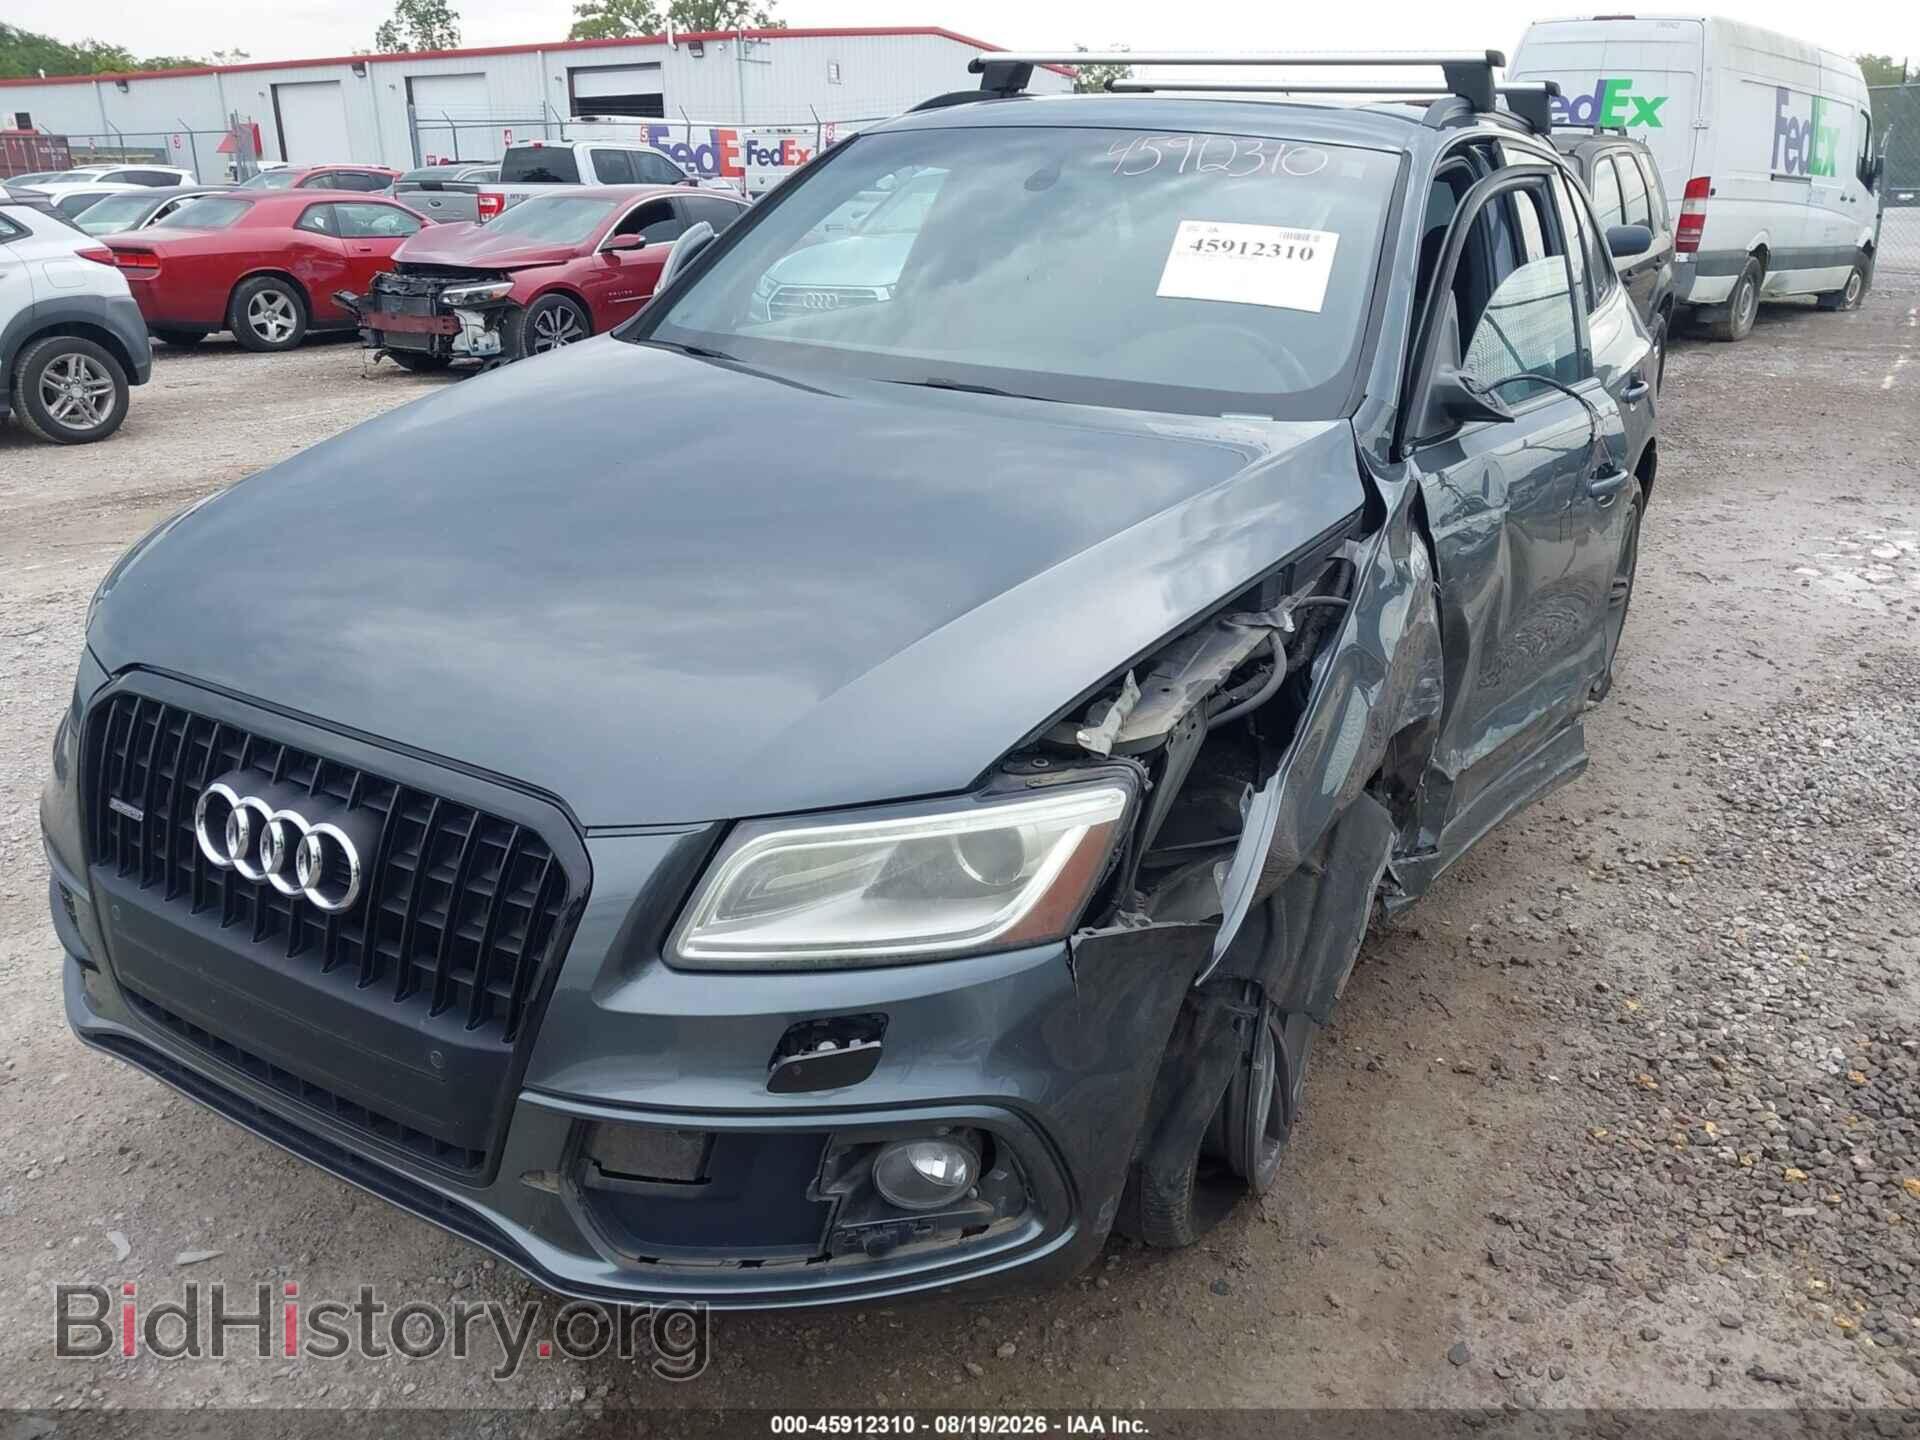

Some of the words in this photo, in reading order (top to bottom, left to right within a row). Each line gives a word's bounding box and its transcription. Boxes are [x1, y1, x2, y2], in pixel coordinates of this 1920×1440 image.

[1550, 78, 1669, 127] edEx
[649, 124, 746, 178] FedE
[746, 139, 813, 166] FedEx
[1771, 87, 1841, 176] FedEx
[1106, 134, 1329, 177] 45912310
[1189, 237, 1315, 262] 45912310
